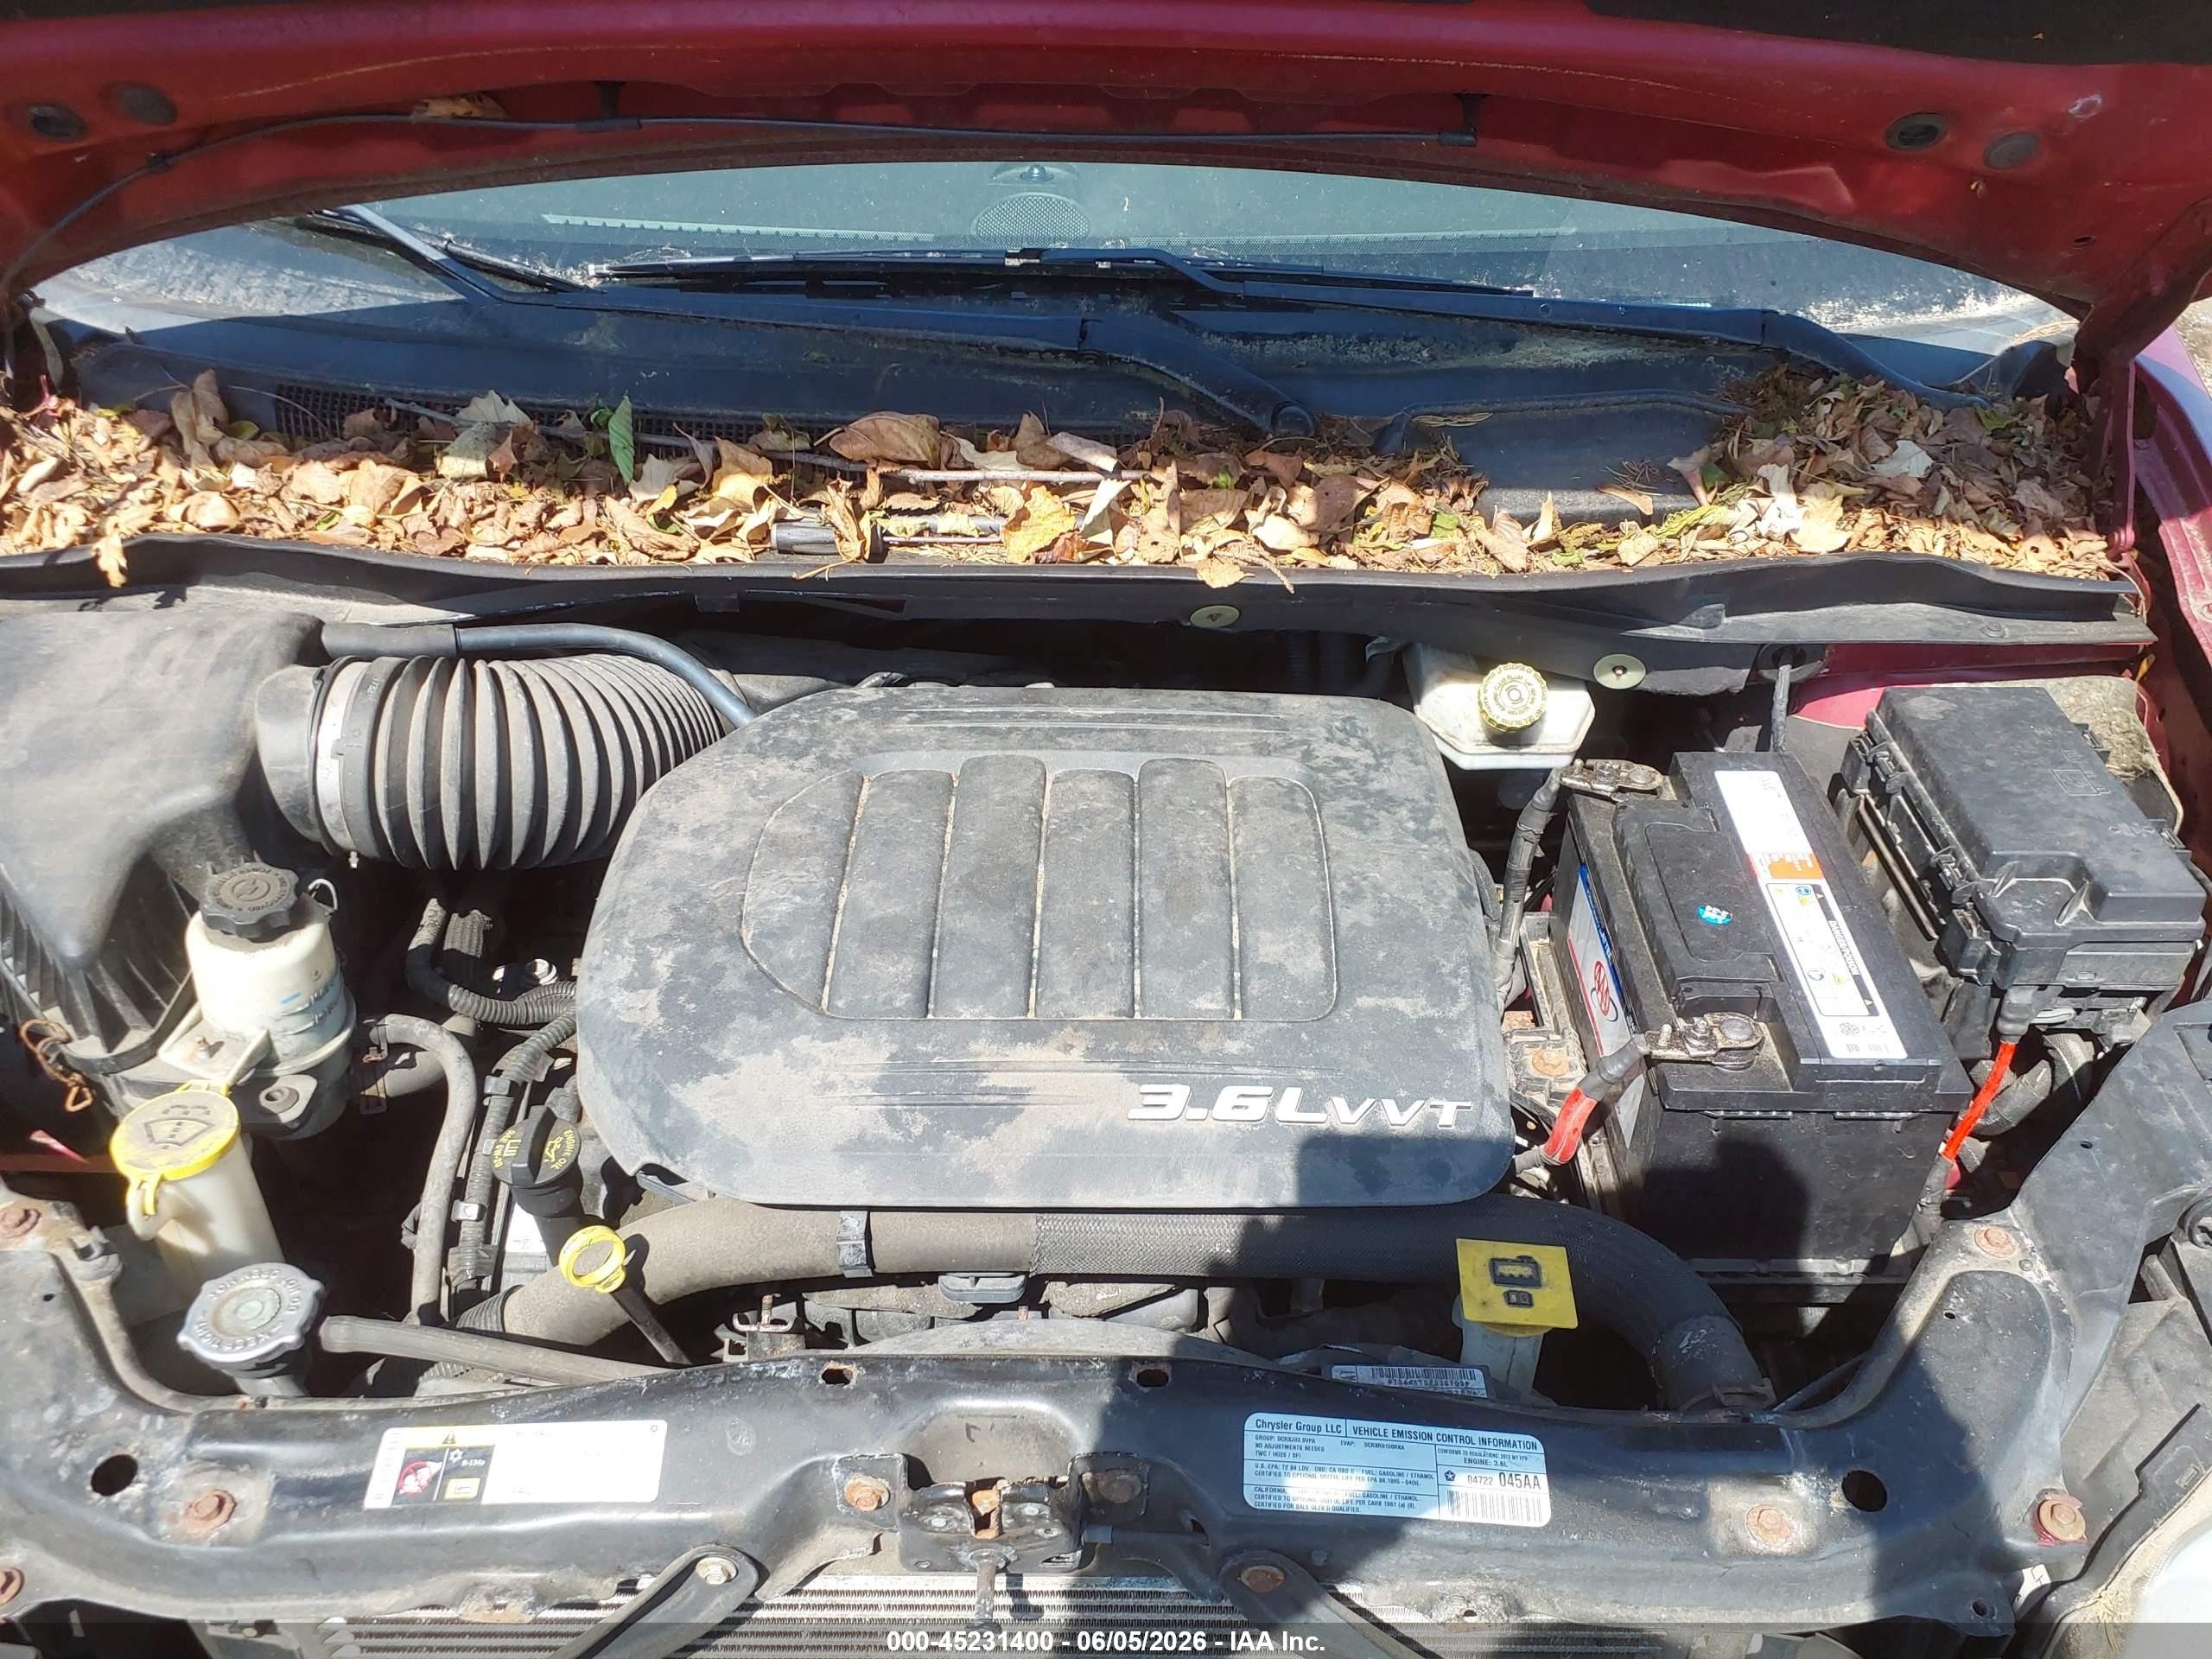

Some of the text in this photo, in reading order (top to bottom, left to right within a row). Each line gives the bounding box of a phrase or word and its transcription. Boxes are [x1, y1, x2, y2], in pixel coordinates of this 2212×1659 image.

[550, 1129, 575, 1170] ENGINE OIL
[1255, 1419, 1342, 1433] Chrysler Group LLC
[1353, 1426, 1537, 1451] VEHICLE EMISSION CONTROL INFORMATION
[1467, 1471, 1541, 1490] 04722 045AA
